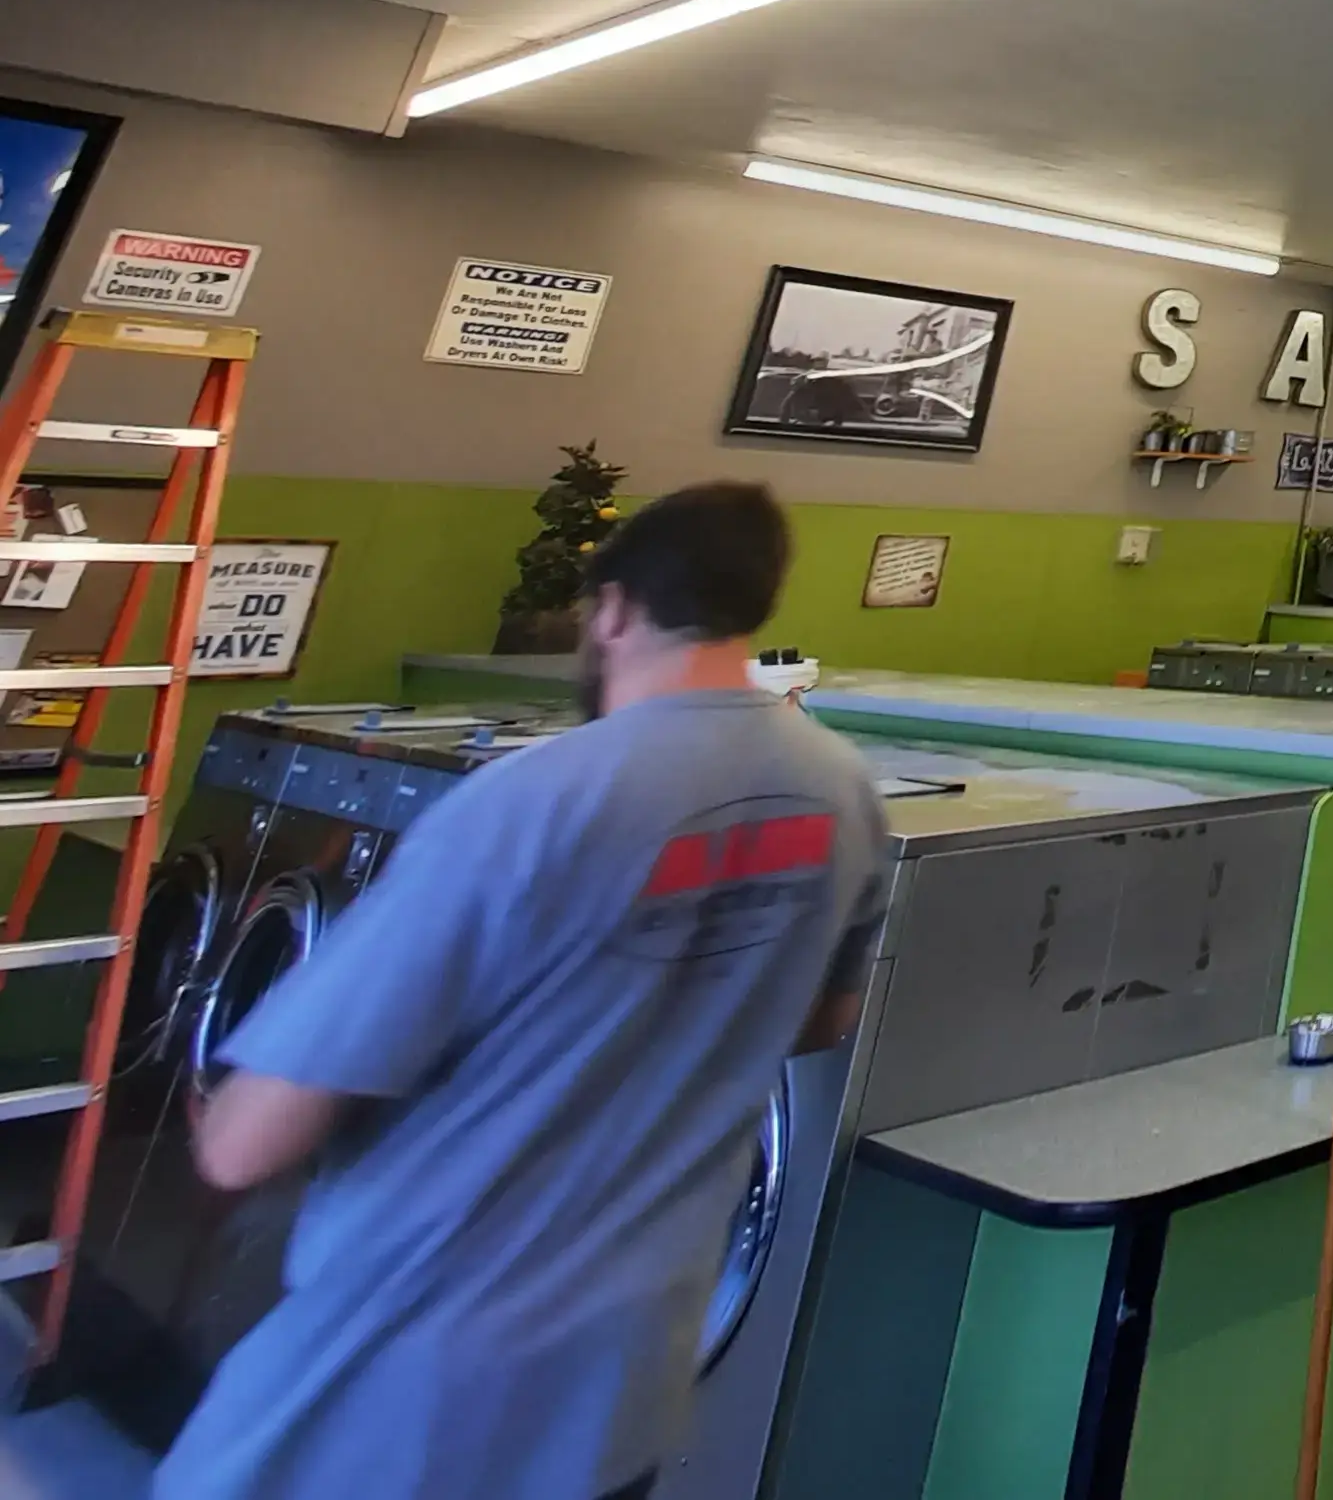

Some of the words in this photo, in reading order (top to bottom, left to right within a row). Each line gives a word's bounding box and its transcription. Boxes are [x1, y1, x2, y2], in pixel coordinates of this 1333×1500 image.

[123, 238, 244, 267] WARNING
[114, 261, 182, 285] Security
[468, 266, 599, 292] NOTICE
[106, 279, 173, 301] Cameras
[176, 286, 193, 302] in
[195, 289, 224, 305] Use
[496, 286, 514, 297] We
[517, 289, 537, 299] Are
[541, 291, 563, 302] Not
[460, 293, 534, 311] Responsible
[538, 303, 558, 314] For
[451, 305, 466, 315] Or
[469, 307, 519, 323] Damage
[524, 313, 537, 324] To
[466, 324, 565, 342] WARNING!
[447, 346, 488, 360] Dryers
[491, 350, 506, 361] At
[508, 353, 535, 364] Own
[460, 335, 483, 346] Use
[487, 338, 537, 352] Washers
[540, 343, 564, 354] And
[209, 561, 316, 579] MEASURE
[238, 594, 287, 617] DO
[191, 633, 284, 660] HAVE
